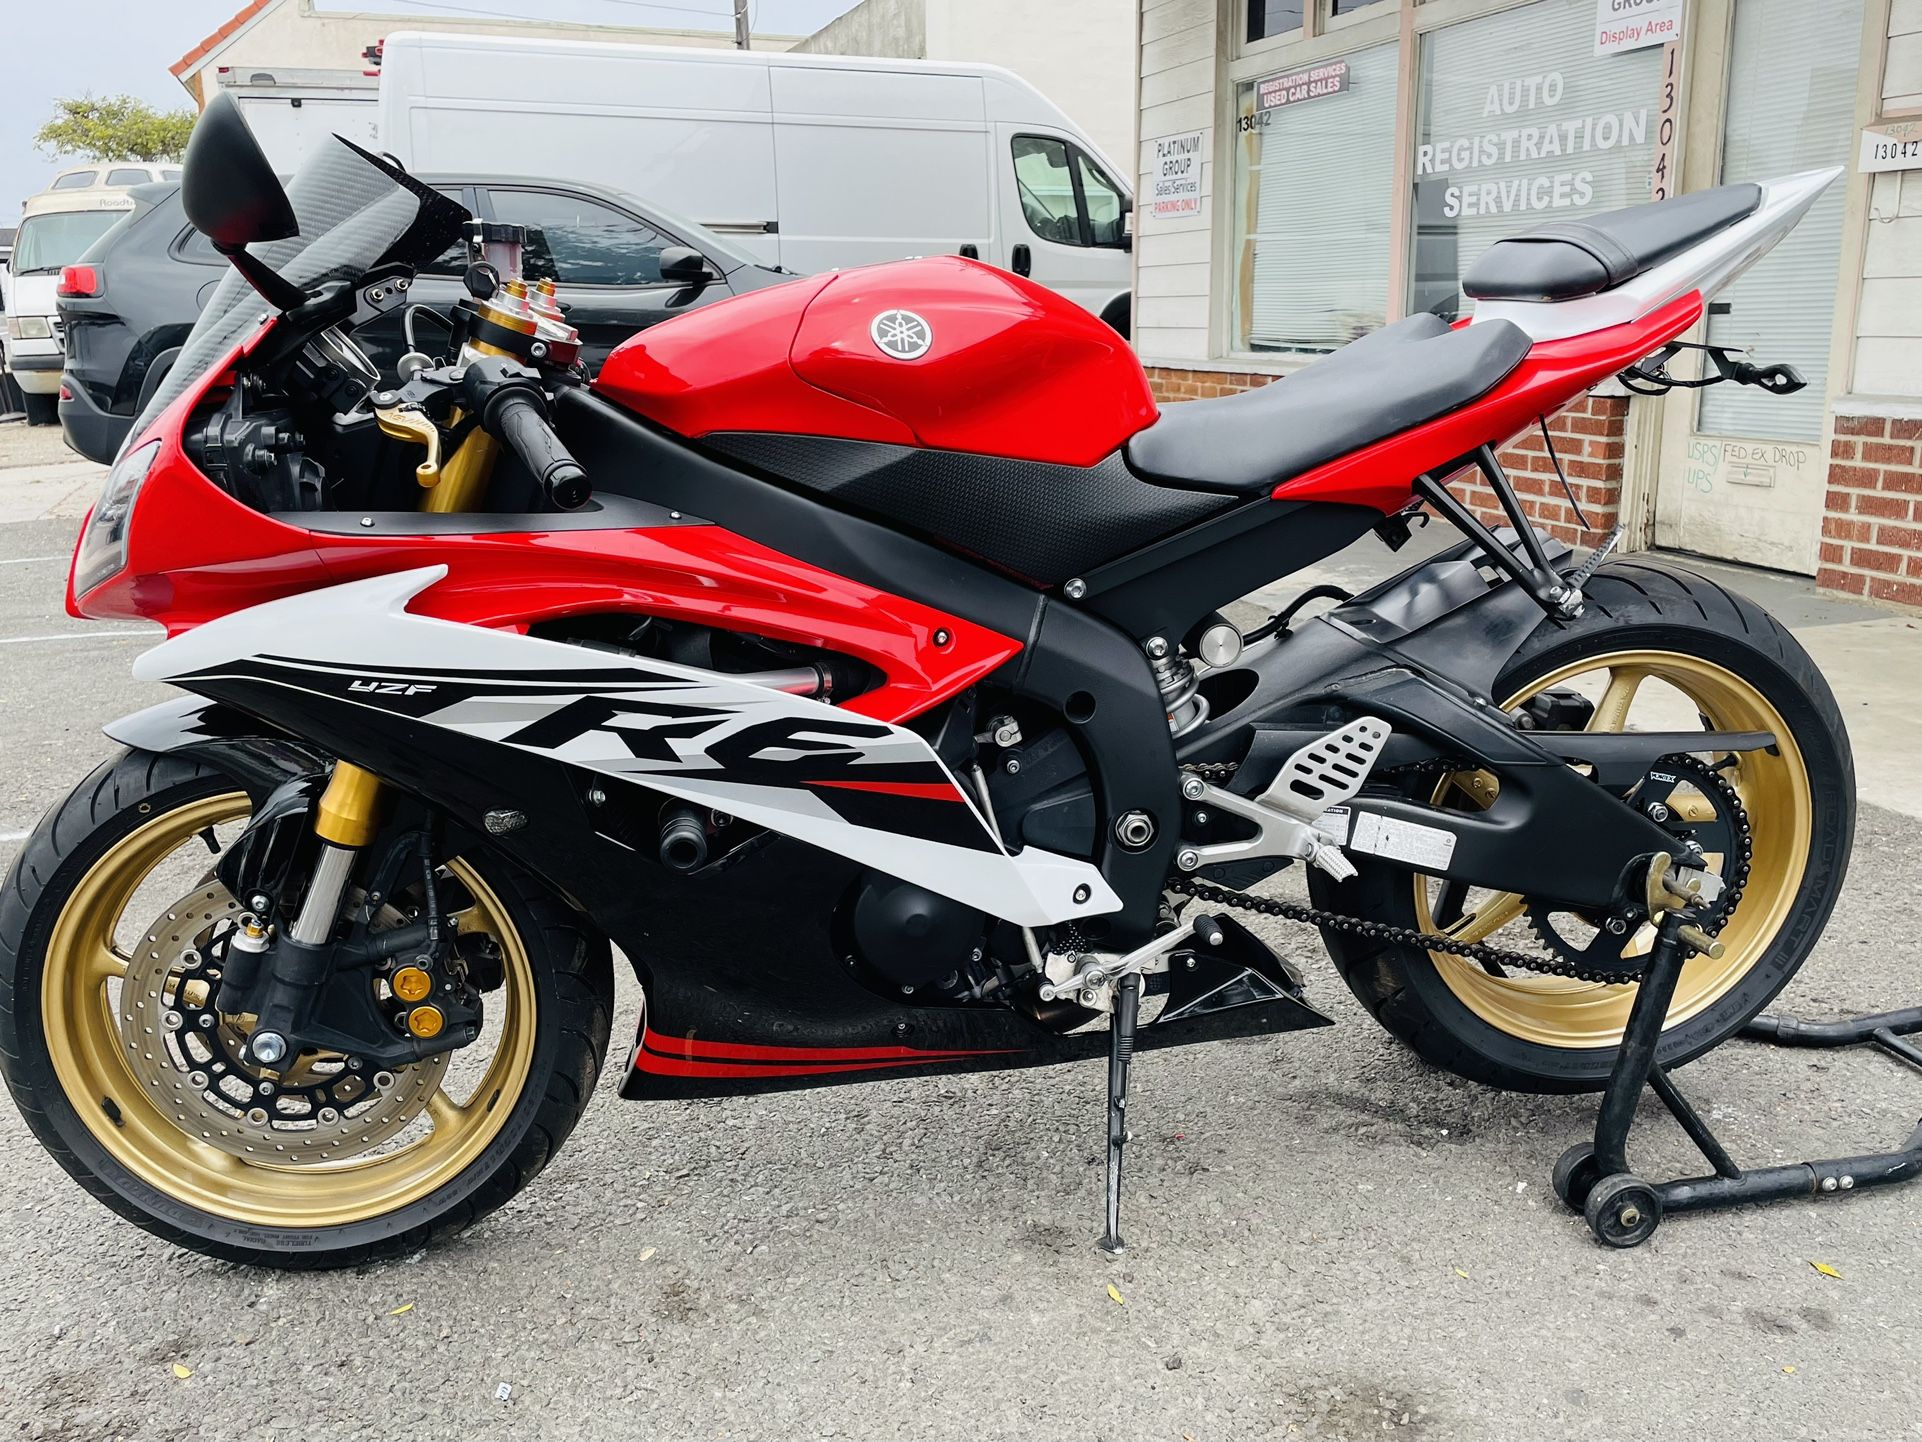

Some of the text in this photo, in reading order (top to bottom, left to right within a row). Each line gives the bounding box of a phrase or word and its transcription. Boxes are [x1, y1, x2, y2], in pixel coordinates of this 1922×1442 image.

[1612, 0, 1661, 11] GRO
[1600, 19, 1673, 45] Display Area
[1260, 63, 1346, 95] REGISTRATION SERVICES
[1263, 77, 1340, 107] USED CAR SALES
[1482, 71, 1564, 117] AUTO
[1236, 111, 1271, 132] 13042
[1157, 136, 1200, 158] PLATINUM
[1417, 108, 1648, 175] REGISTRATION
[1874, 141, 1918, 160] 13042
[1162, 158, 1191, 176] GROUP
[1154, 198, 1198, 213] PARKING ONLY
[1443, 171, 1594, 217] SERVICES
[1773, 446, 1806, 471] DROP
[1688, 467, 1712, 493] UPS
[347, 680, 437, 696] YZF
[500, 695, 895, 769] R6
